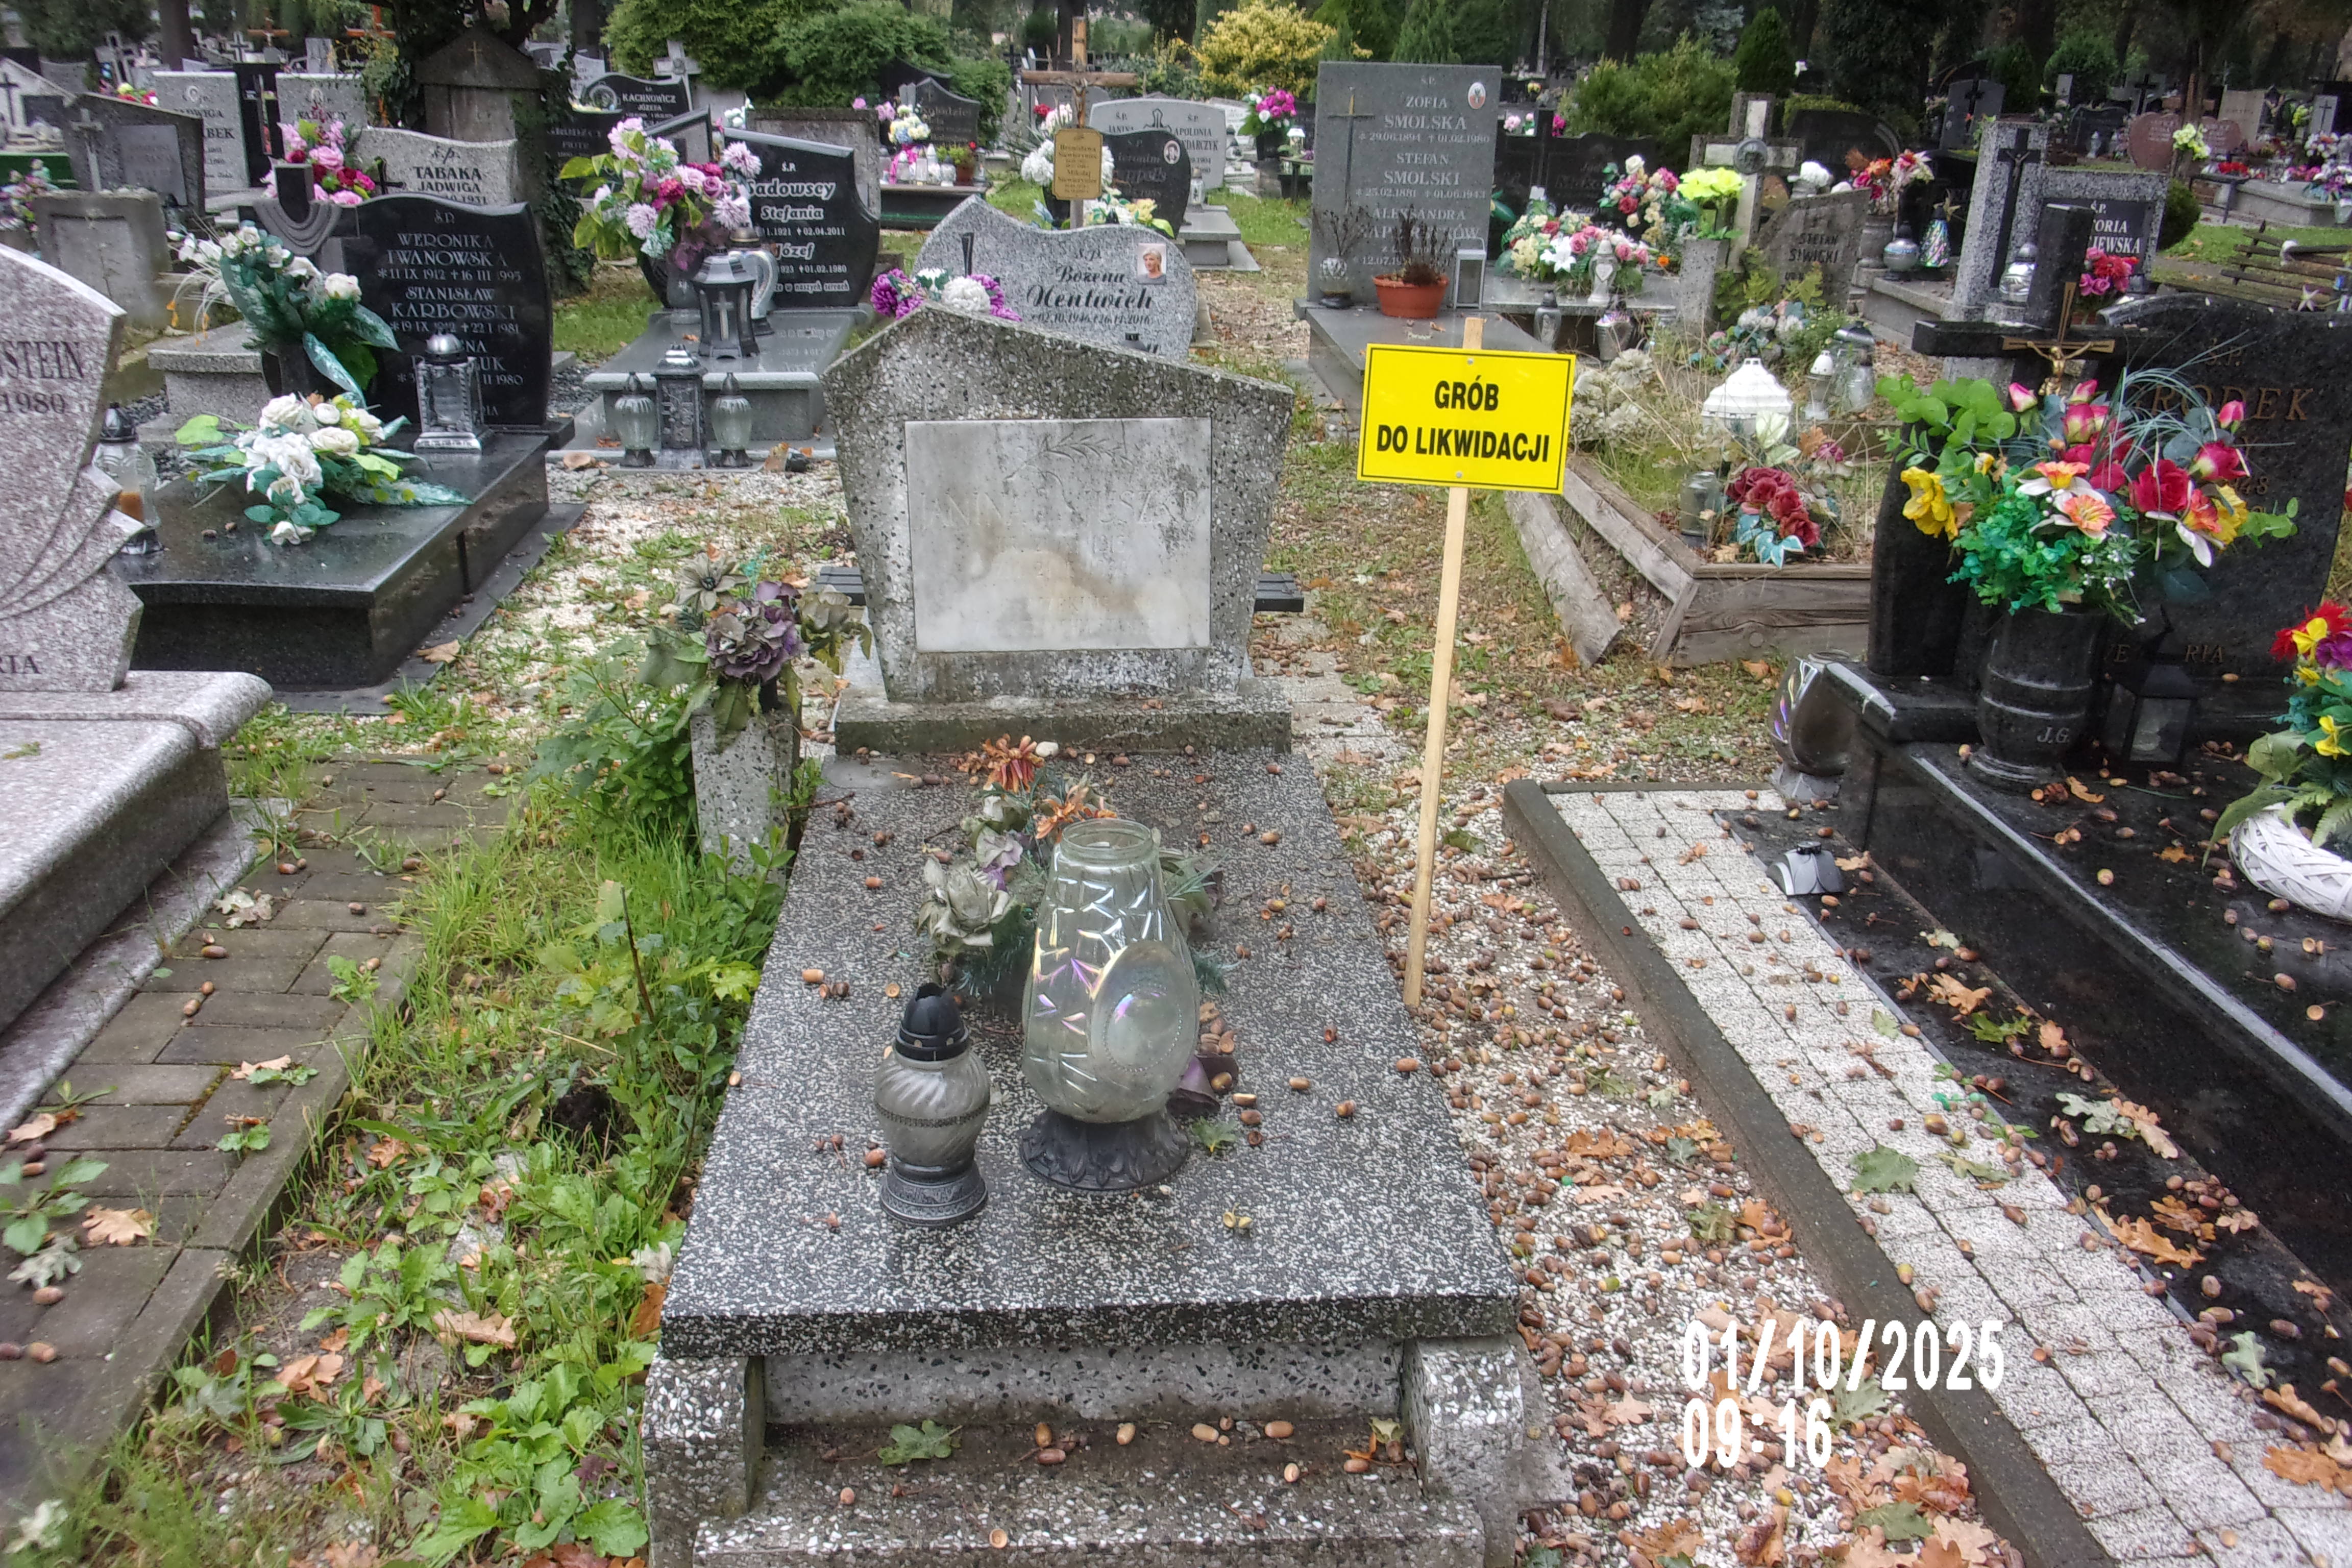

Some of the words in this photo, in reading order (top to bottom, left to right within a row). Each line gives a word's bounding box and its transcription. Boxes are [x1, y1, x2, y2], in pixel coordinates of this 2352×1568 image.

[1406, 95, 1448, 108] ZOFIA
[1385, 115, 1467, 130] SMOLSKA
[1175, 128, 1212, 136] APOLONIA
[1397, 153, 1450, 164] STEFAN
[413, 166, 482, 180] TABAKA
[1385, 170, 1460, 185] SMOLSKI
[418, 181, 481, 193] JADWIGA
[747, 177, 836, 201] Sadowscy
[761, 204, 824, 223] Stefania
[2094, 219, 2128, 233] ORIA
[397, 232, 494, 248] WERONIKA
[2090, 235, 2141, 254] IEWSKA
[387, 249, 508, 267] IWANOWSKA
[776, 242, 815, 260] Józef
[423, 268, 446, 280] 1912
[1056, 265, 1124, 283] Bożena
[406, 286, 495, 301] STANISŁAW
[794, 280, 822, 294] naszych
[1026, 284, 1153, 309] Hentwich
[391, 302, 515, 320] KARBOWSKI
[0, 340, 84, 379] STEIN
[1434, 375, 1500, 411] GRÓB
[1377, 424, 1408, 453] DO
[1416, 427, 1550, 462] LIKWIDACJI
